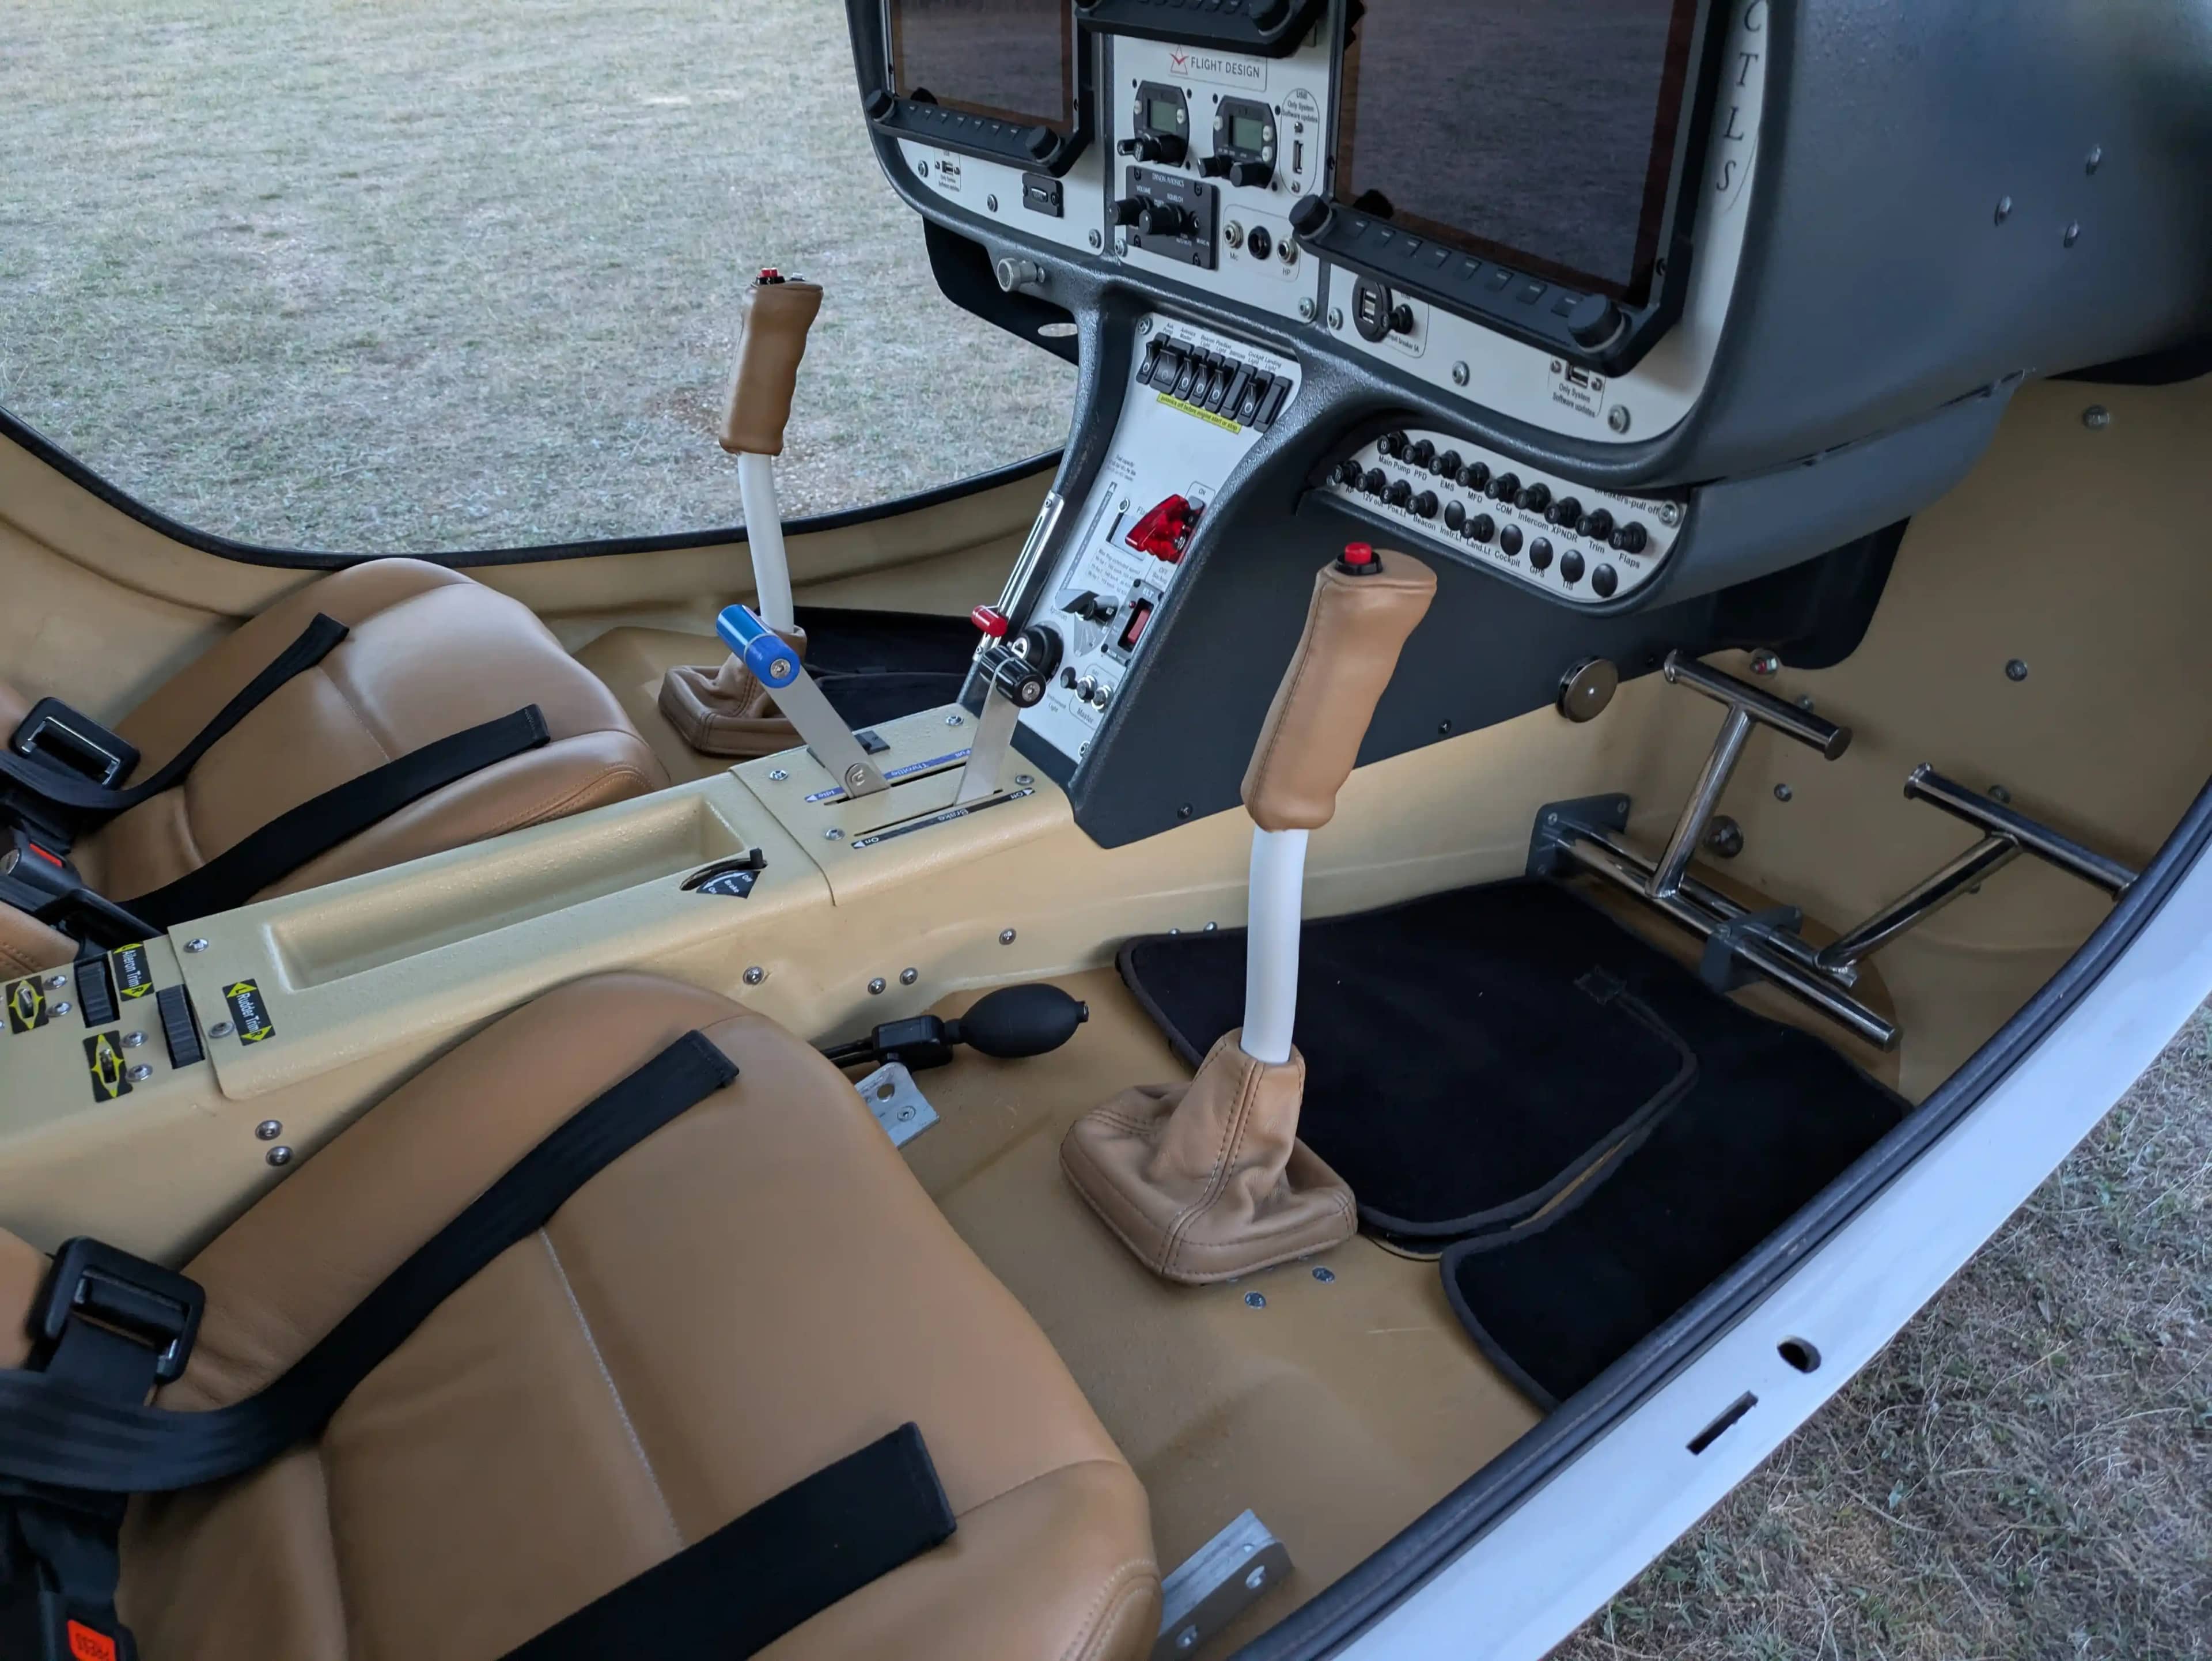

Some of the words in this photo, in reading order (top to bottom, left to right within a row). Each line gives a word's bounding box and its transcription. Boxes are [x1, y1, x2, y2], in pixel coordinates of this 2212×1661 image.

[1191, 56, 1222, 73] FLIGHT
[1225, 61, 1260, 78] DESIGN
[1716, 1, 1760, 191] CTLS
[1136, 184, 1151, 195] VOLUME
[1282, 267, 1291, 277] HP
[1559, 383, 1570, 396] Only
[1571, 388, 1590, 403] System
[1552, 392, 1574, 408] Software
[1575, 404, 1596, 418] updates
[1183, 404, 1196, 414] before
[1211, 416, 1222, 424] start
[1380, 439, 1387, 450] 10
[1378, 455, 1392, 466] Main
[1394, 461, 1411, 475] Pump
[1414, 470, 1427, 481] PFD
[1440, 479, 1455, 491] EMS
[1363, 492, 1373, 503] 12V
[1467, 490, 1483, 503] MFD
[1496, 503, 1513, 516] COM
[1413, 513, 1436, 531] Beacon
[1518, 511, 1548, 531] Intercom
[1551, 524, 1578, 543] XPNDR
[1589, 540, 1605, 554] Trim
[1494, 550, 1521, 567] Cockpit
[1619, 553, 1641, 569] Flaps
[1529, 565, 1545, 577] GPS
[1077, 707, 1094, 724] Master
[891, 763, 927, 777] Throttle
[818, 790, 835, 798] Idle
[938, 808, 968, 822] Brake
[724, 879, 740, 893] Brake
[122, 949, 137, 973] Aileron
[127, 970, 142, 987] Trim
[236, 992, 255, 1017] Rudder
[245, 1015, 261, 1033] Trim
